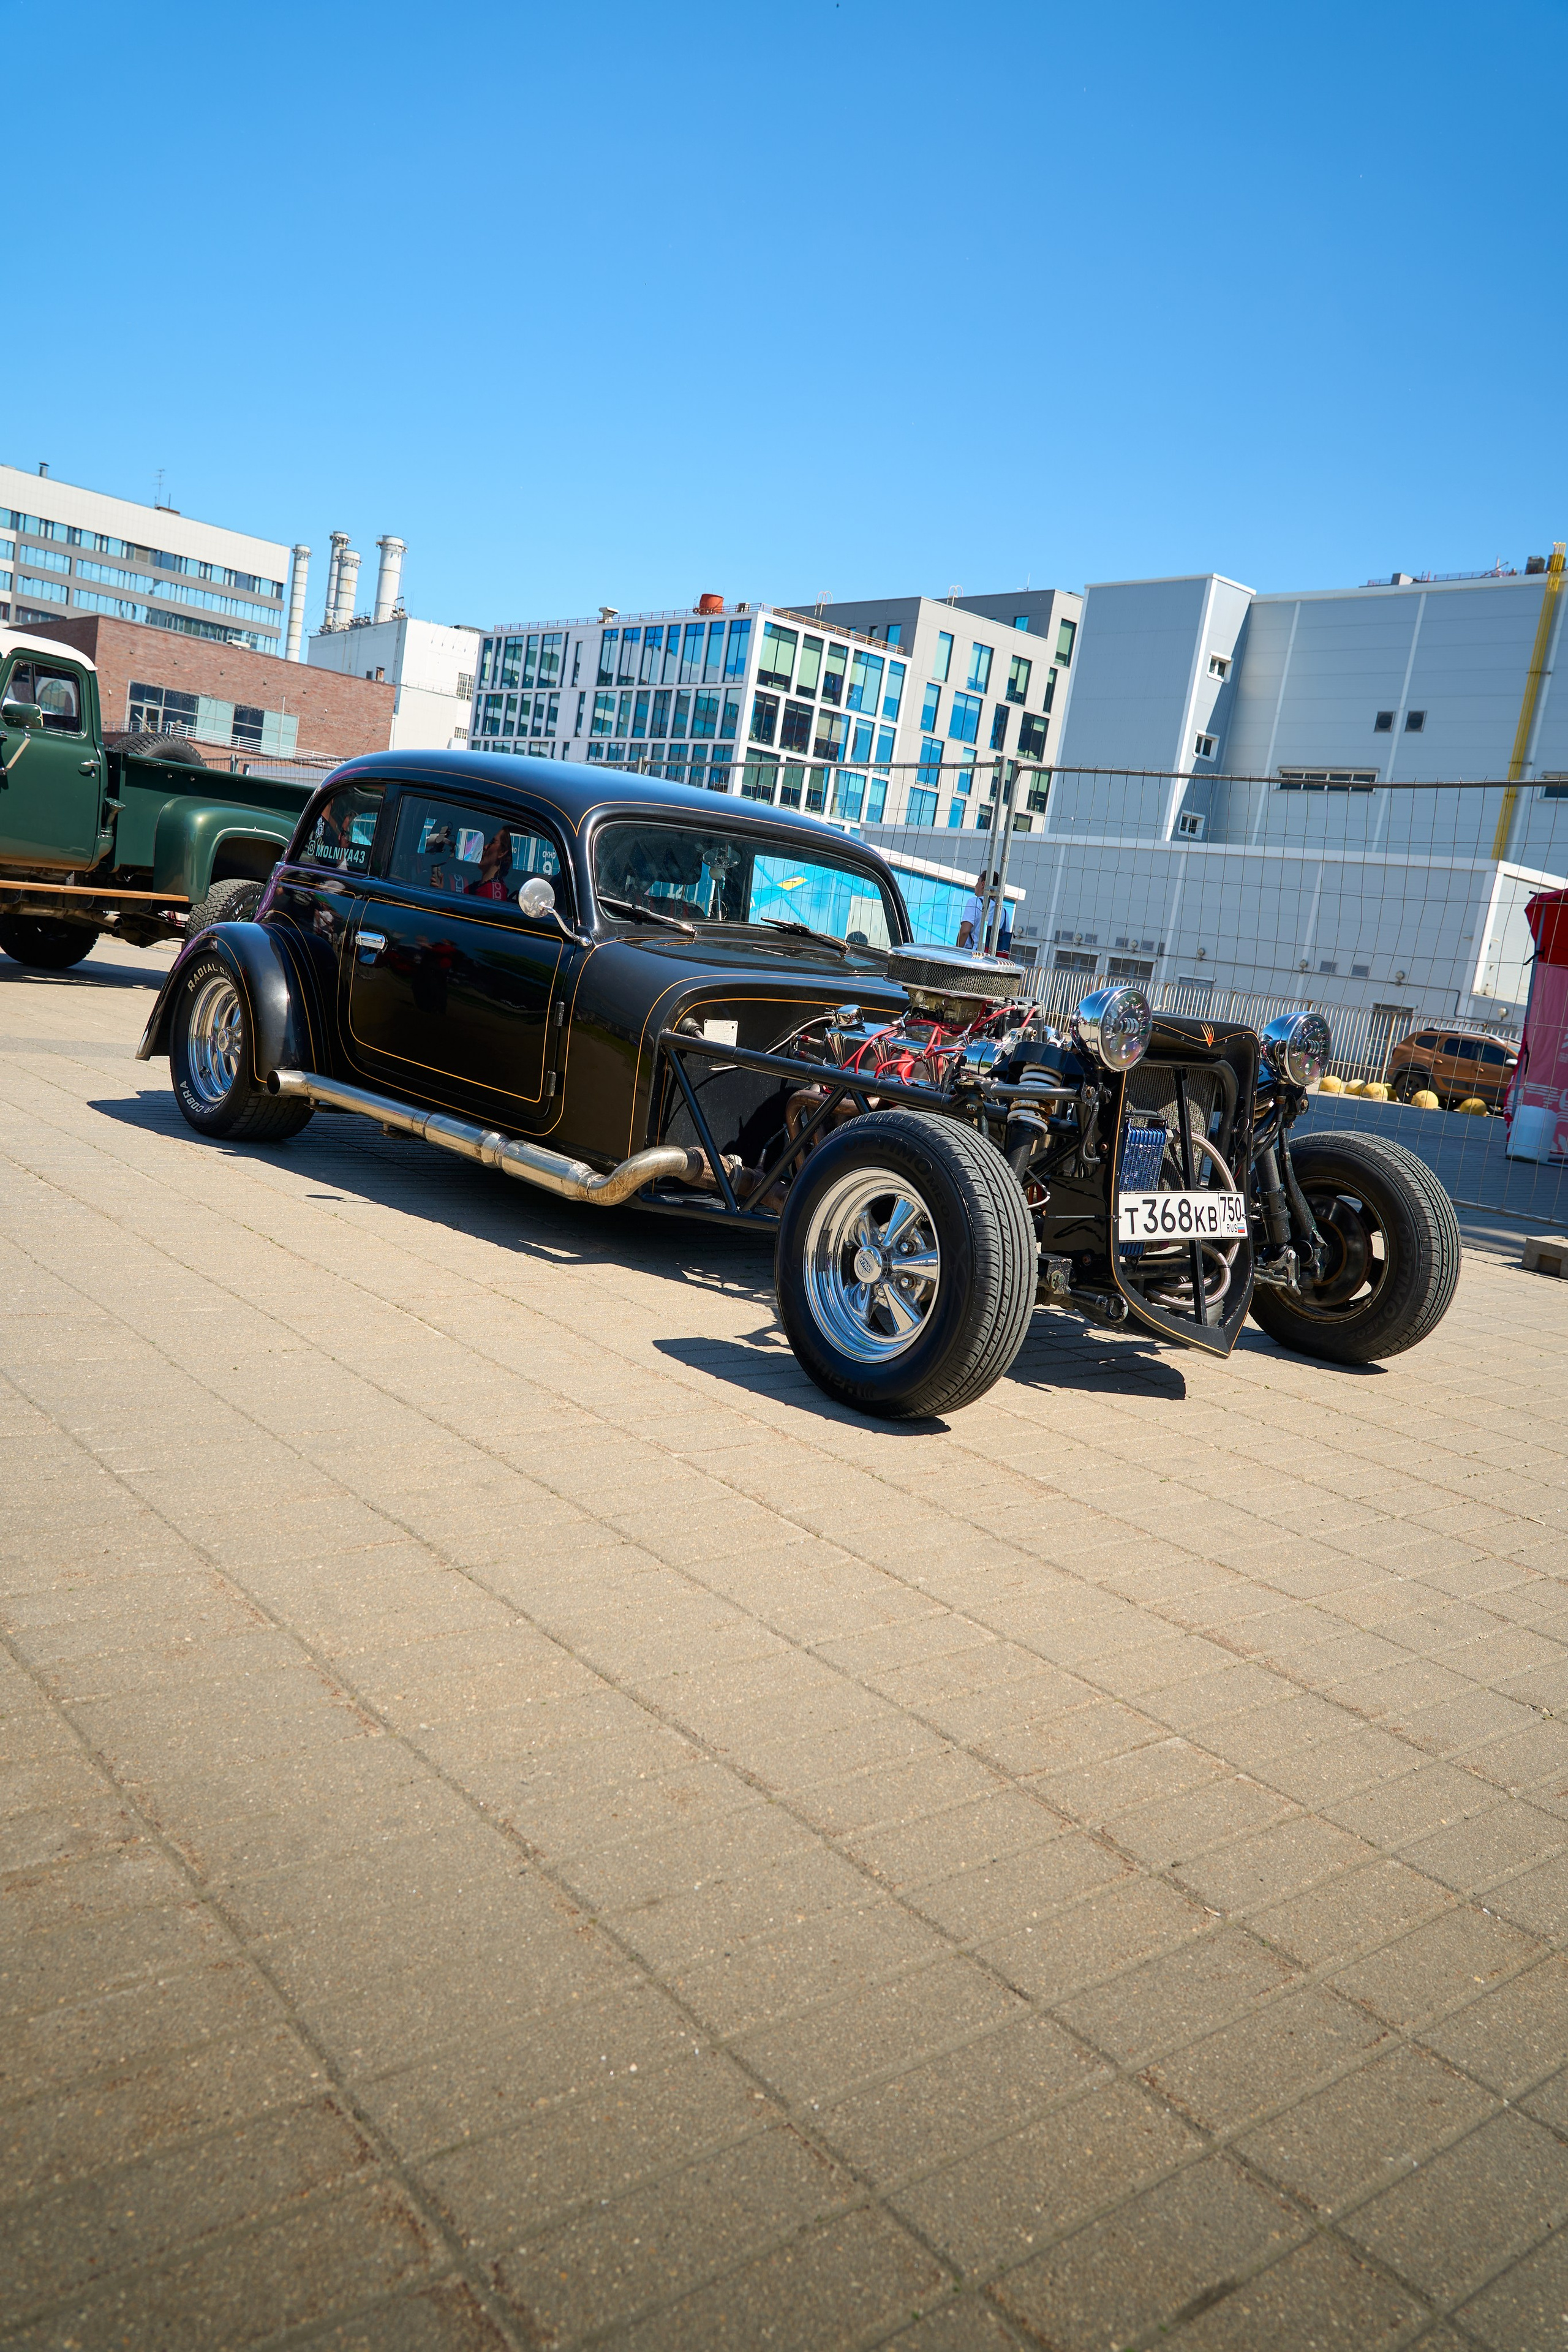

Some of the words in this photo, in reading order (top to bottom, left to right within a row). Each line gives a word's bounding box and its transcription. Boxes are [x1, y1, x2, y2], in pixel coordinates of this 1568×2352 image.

[315, 843, 366, 864] MOLNIYA43
[187, 963, 219, 992] RADIAL
[179, 1080, 205, 1113] COBRA
[844, 1133, 933, 1176] OPTIMO
[1125, 1199, 1218, 1235] Т368КВ
[1220, 1197, 1242, 1223] 750
[1226, 1224, 1237, 1233] RUS
[1384, 1223, 1412, 1319] OPTIMO
